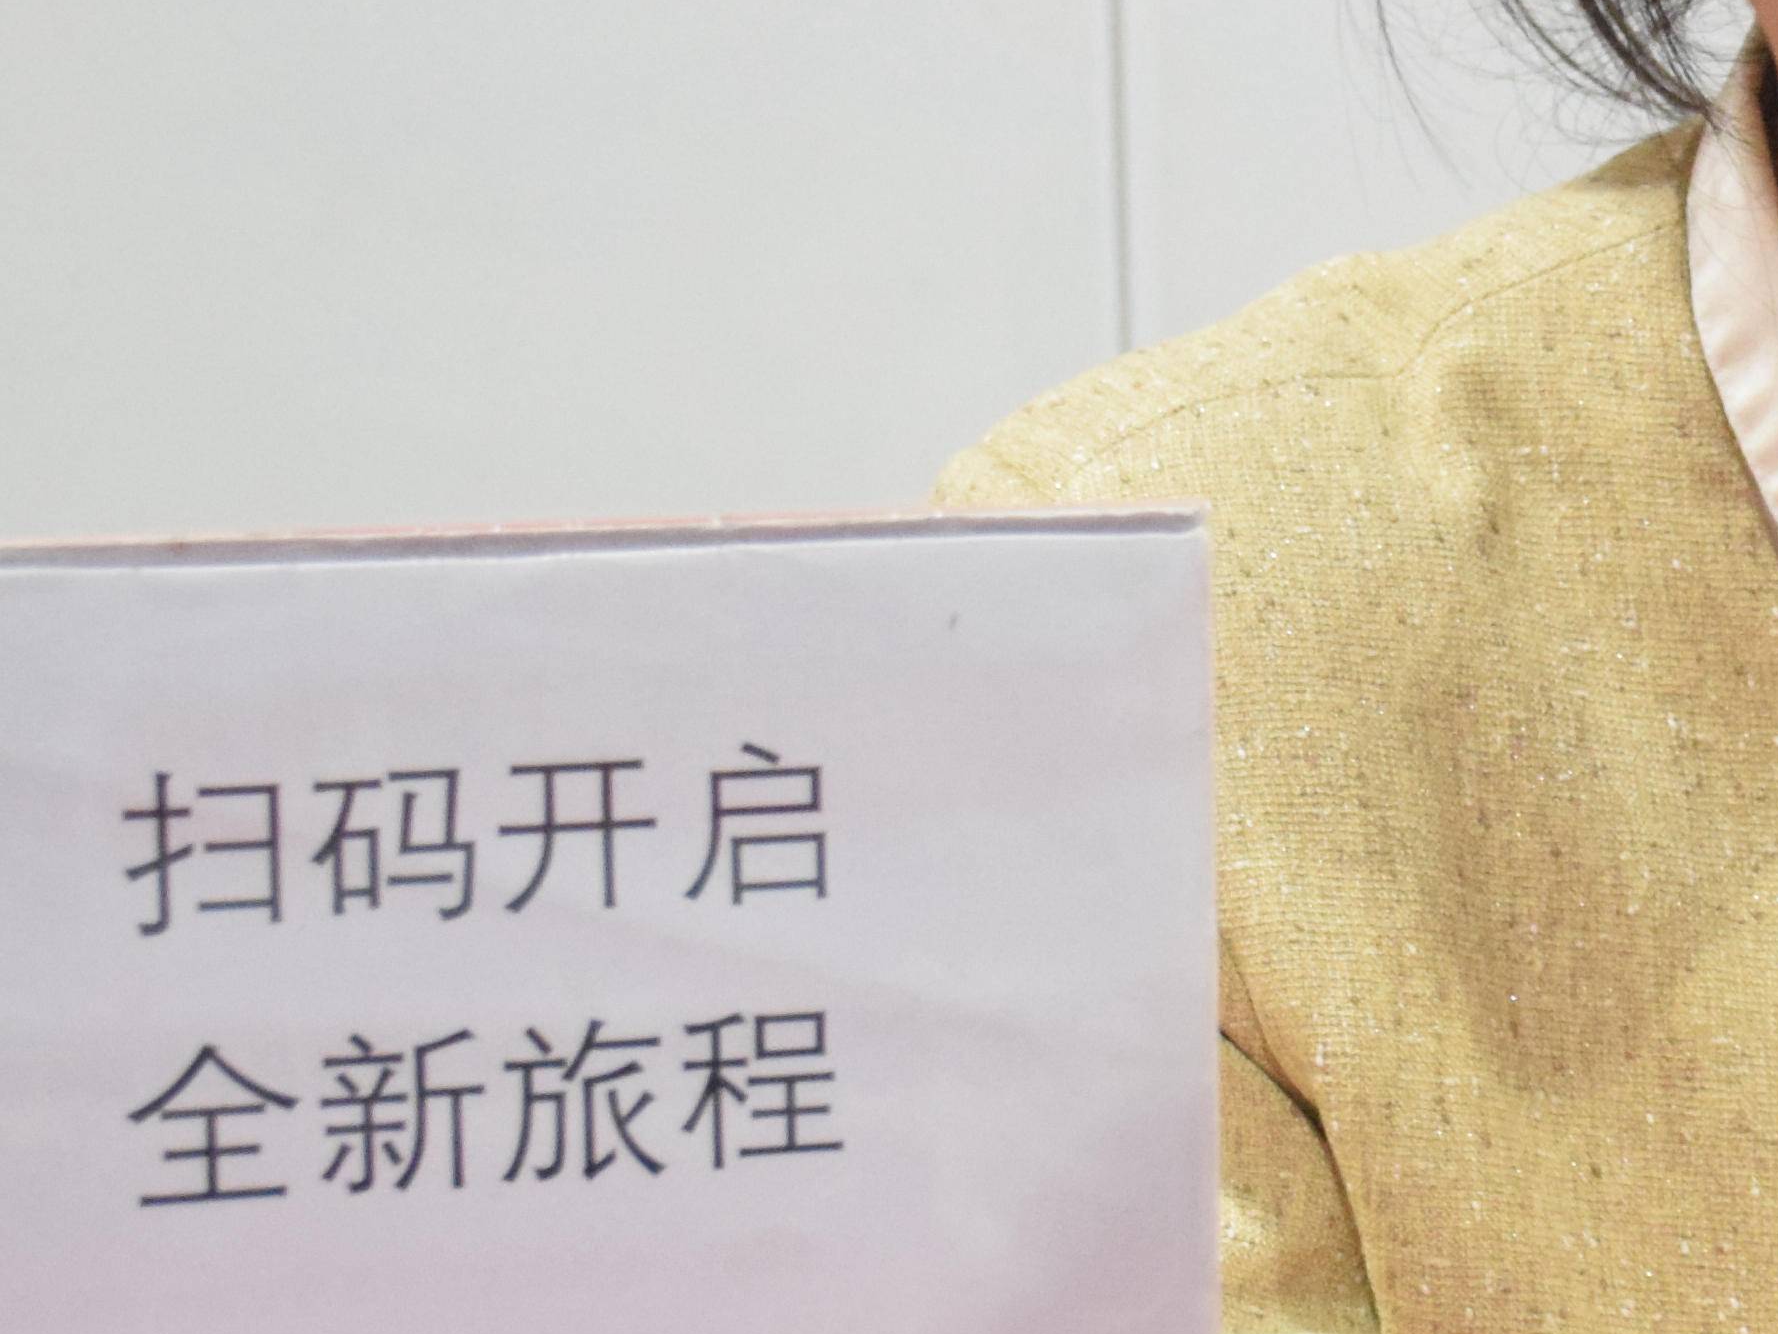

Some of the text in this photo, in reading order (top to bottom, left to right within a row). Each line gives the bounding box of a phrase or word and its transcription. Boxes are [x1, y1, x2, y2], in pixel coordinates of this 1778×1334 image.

[121, 742, 829, 935] 扫码开启
[127, 1010, 845, 1208] 全新旅程
